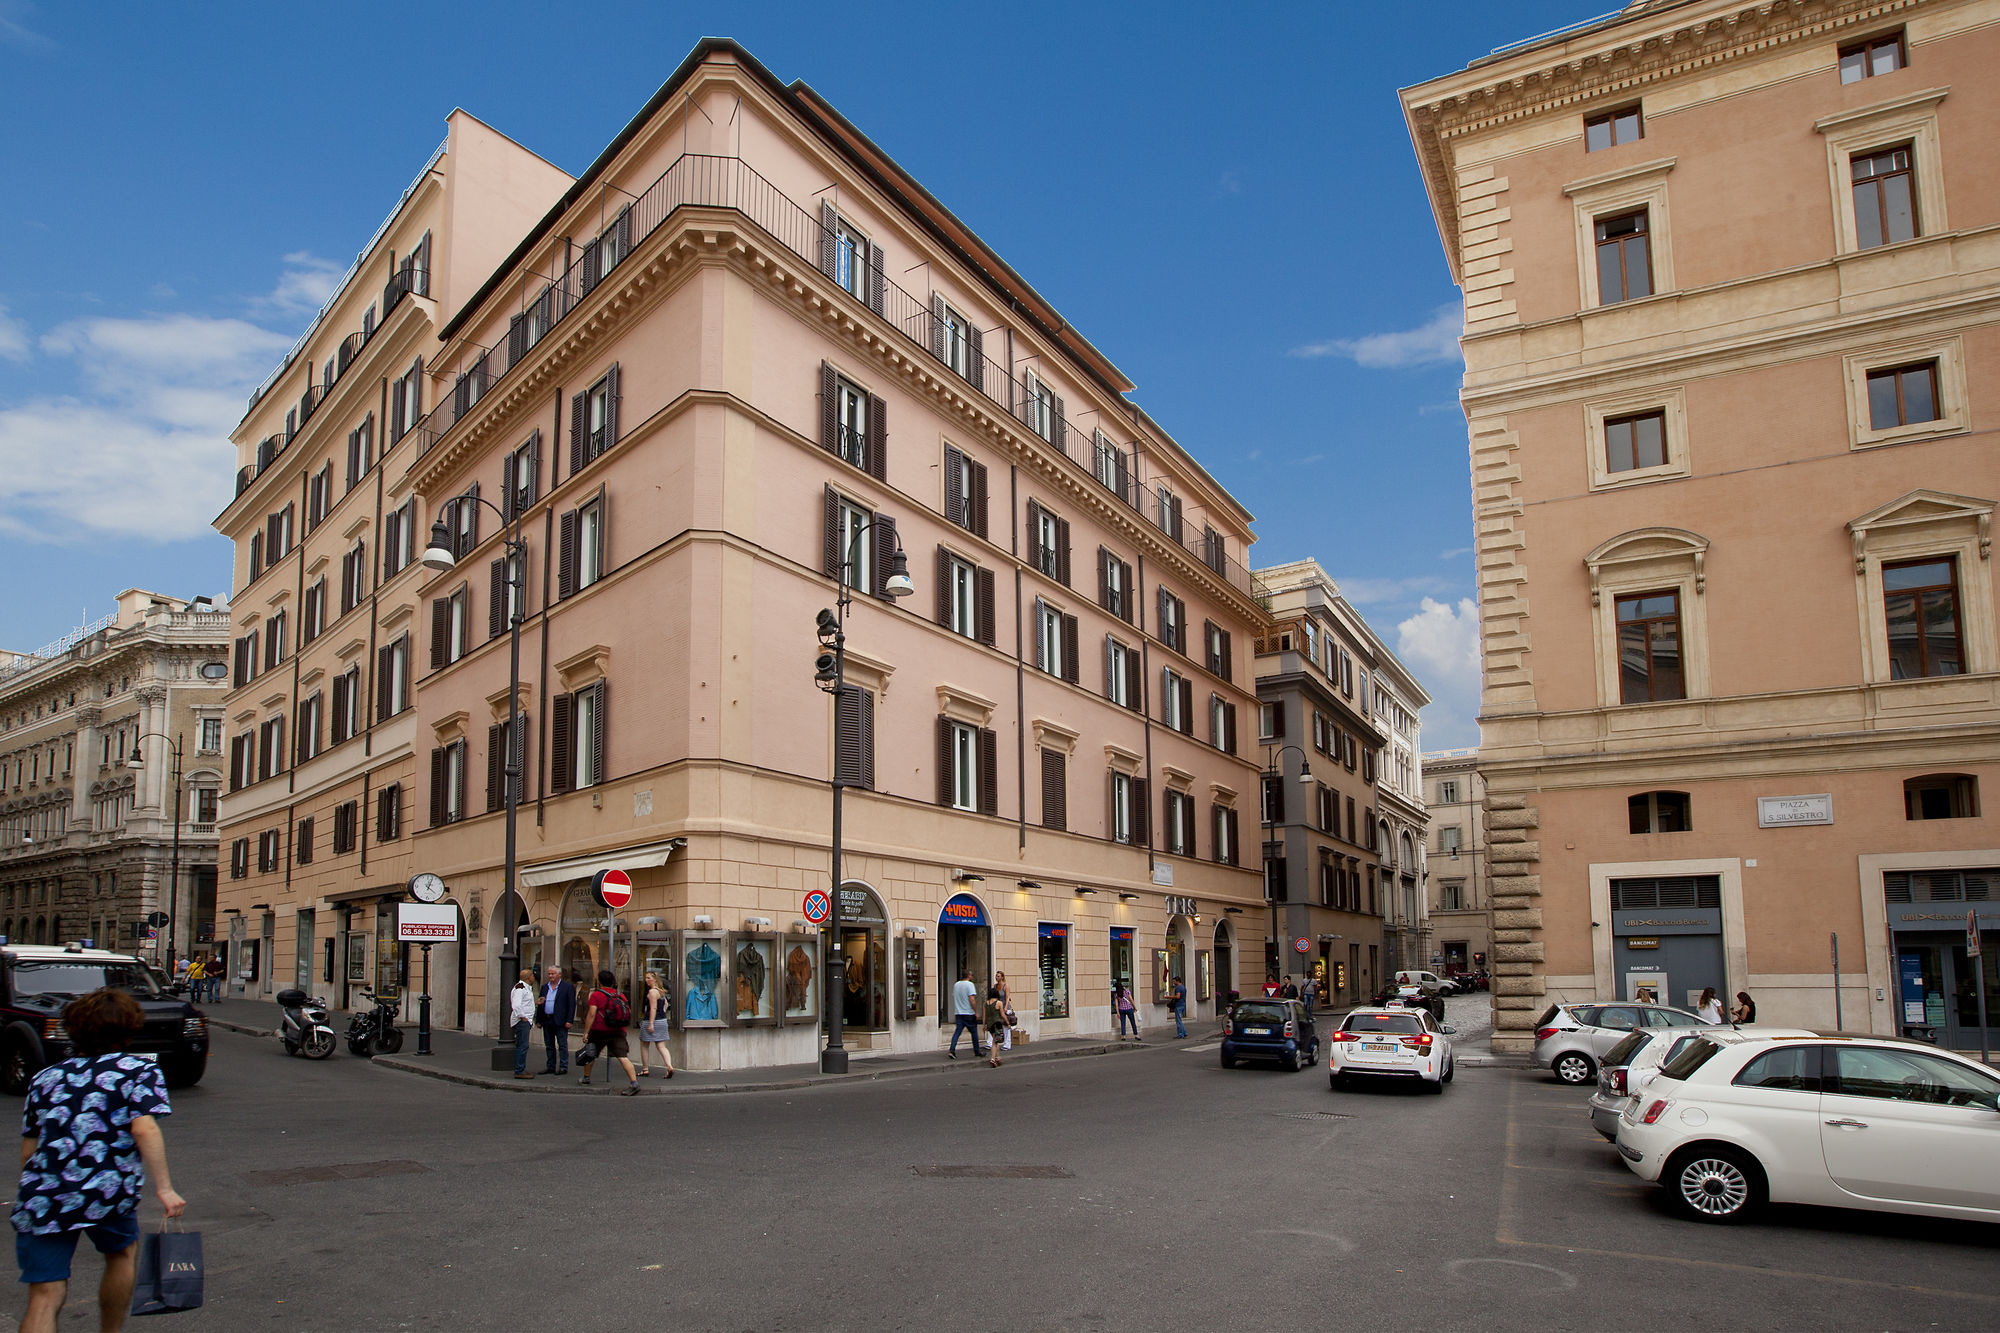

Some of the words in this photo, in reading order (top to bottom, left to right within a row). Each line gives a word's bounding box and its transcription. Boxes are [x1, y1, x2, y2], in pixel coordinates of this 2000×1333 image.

[1780, 801, 1809, 809] PIAZZA
[1776, 811, 1824, 821] SILVESTRO
[1165, 895, 1197, 916] TRIS
[402, 928, 454, 936] 06.58.33.33.88
[169, 1262, 197, 1272] ZARA
